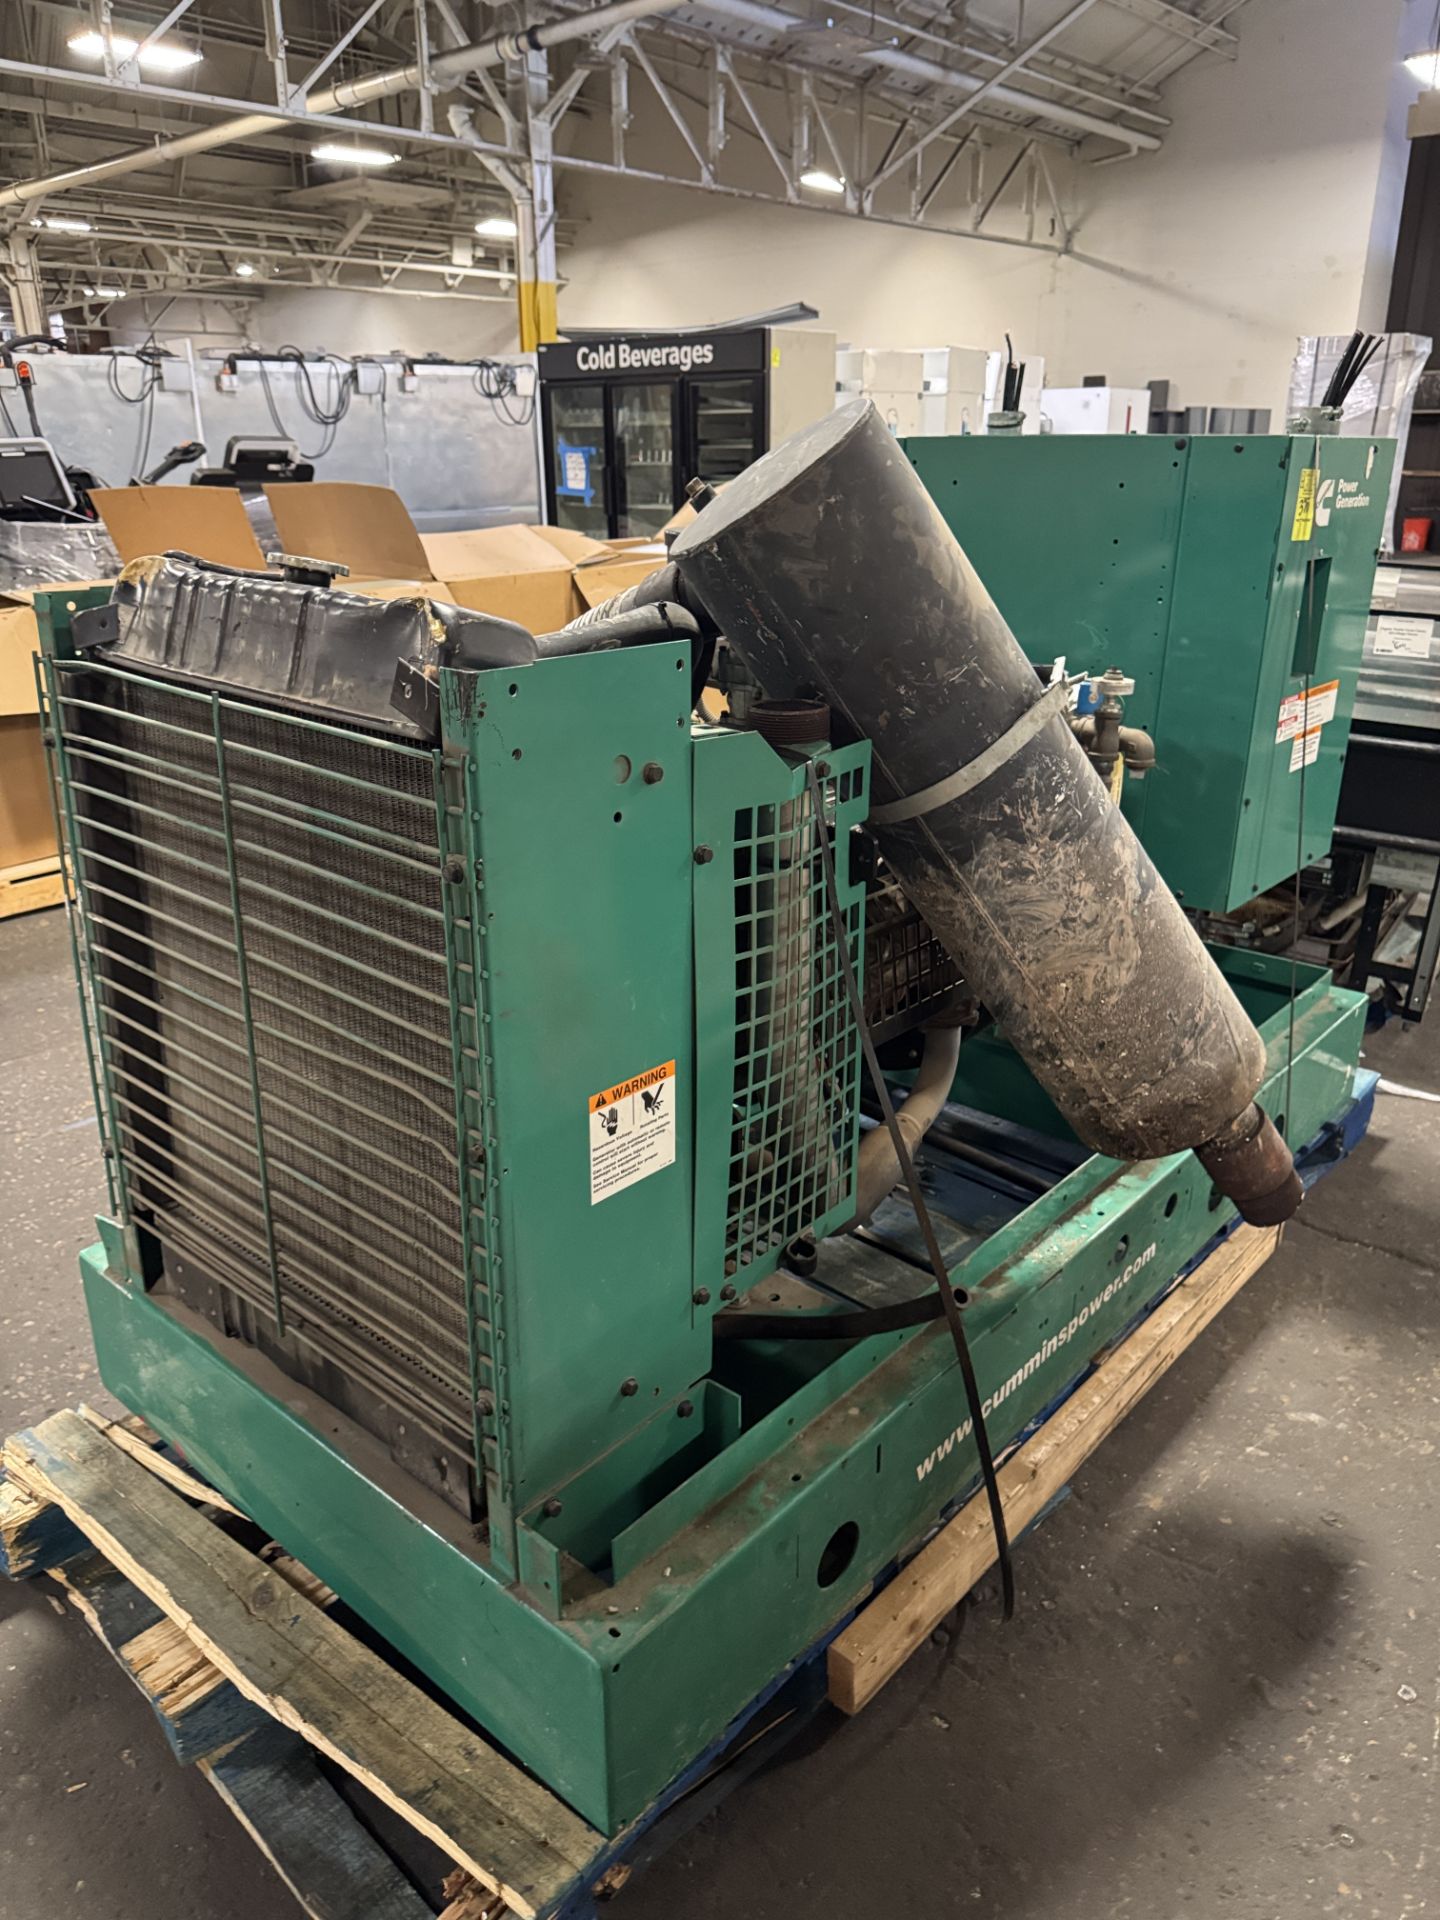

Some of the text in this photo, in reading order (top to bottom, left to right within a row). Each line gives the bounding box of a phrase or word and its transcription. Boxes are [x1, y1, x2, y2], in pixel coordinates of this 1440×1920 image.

[576, 343, 714, 372] Cold Beverages
[1337, 478, 1359, 493] Power
[1335, 492, 1370, 509] Generation
[611, 1066, 667, 1100] WARNING
[916, 1243, 1157, 1482] wwwcumminspower.com
